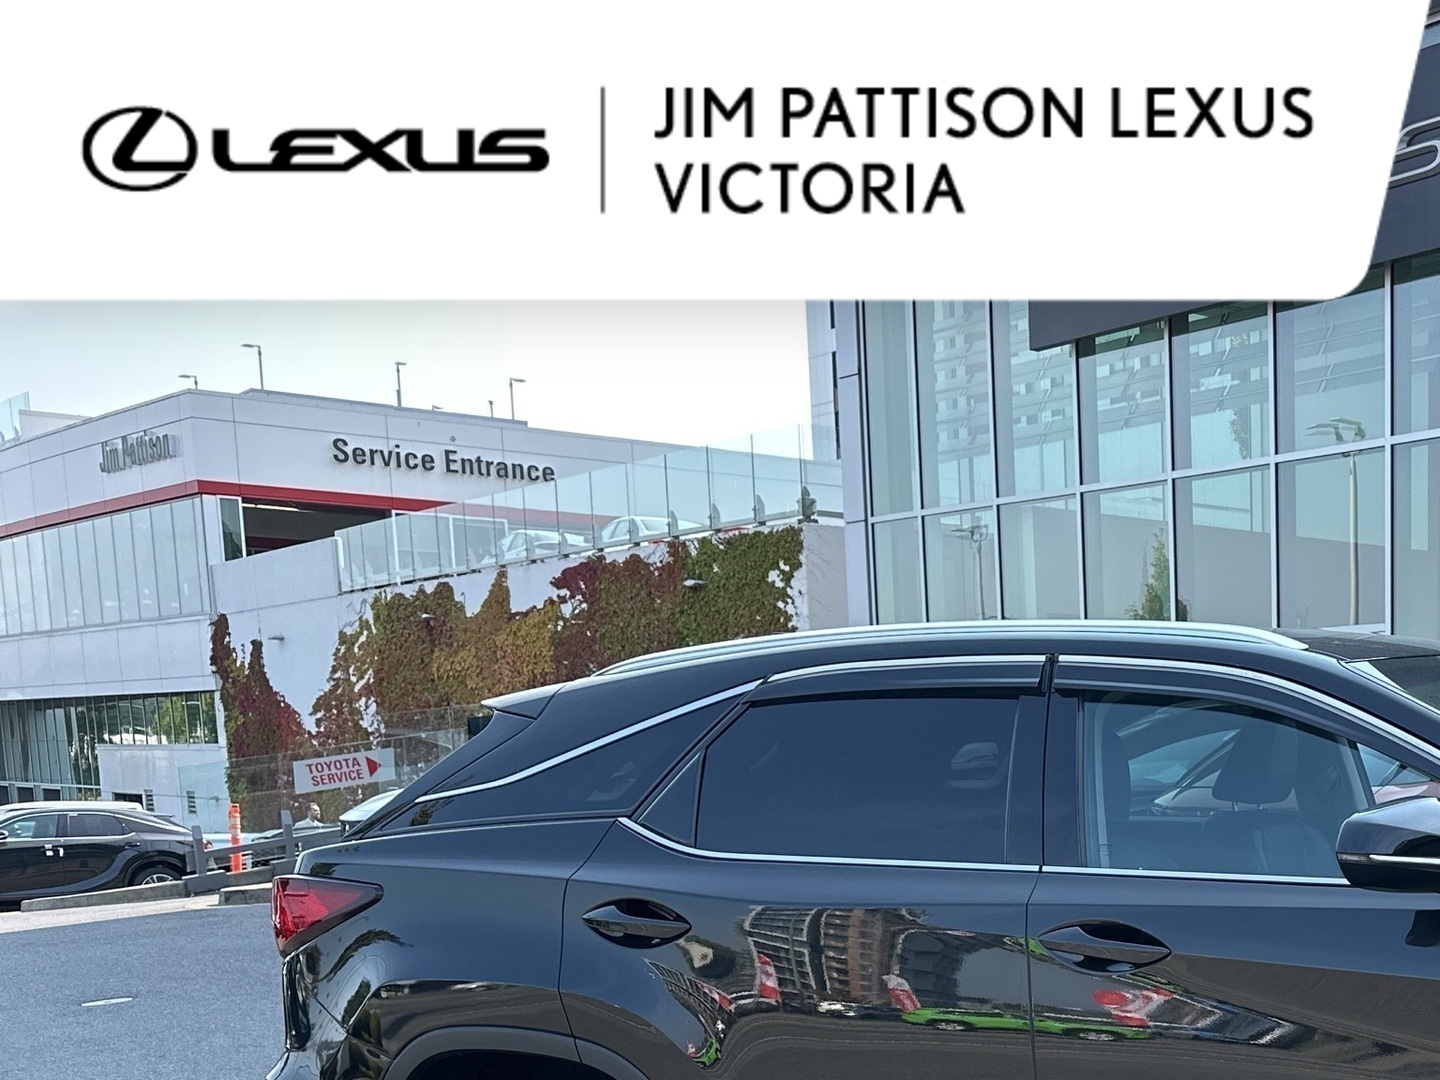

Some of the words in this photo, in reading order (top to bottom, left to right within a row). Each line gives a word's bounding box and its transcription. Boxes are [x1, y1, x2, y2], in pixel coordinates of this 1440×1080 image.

[99, 441, 120, 473] Jim
[121, 431, 173, 469] Pattison
[332, 438, 435, 471] Service
[444, 449, 555, 482] Entrance
[306, 757, 361, 774] TOYOTA
[311, 769, 364, 787] SERVICE
